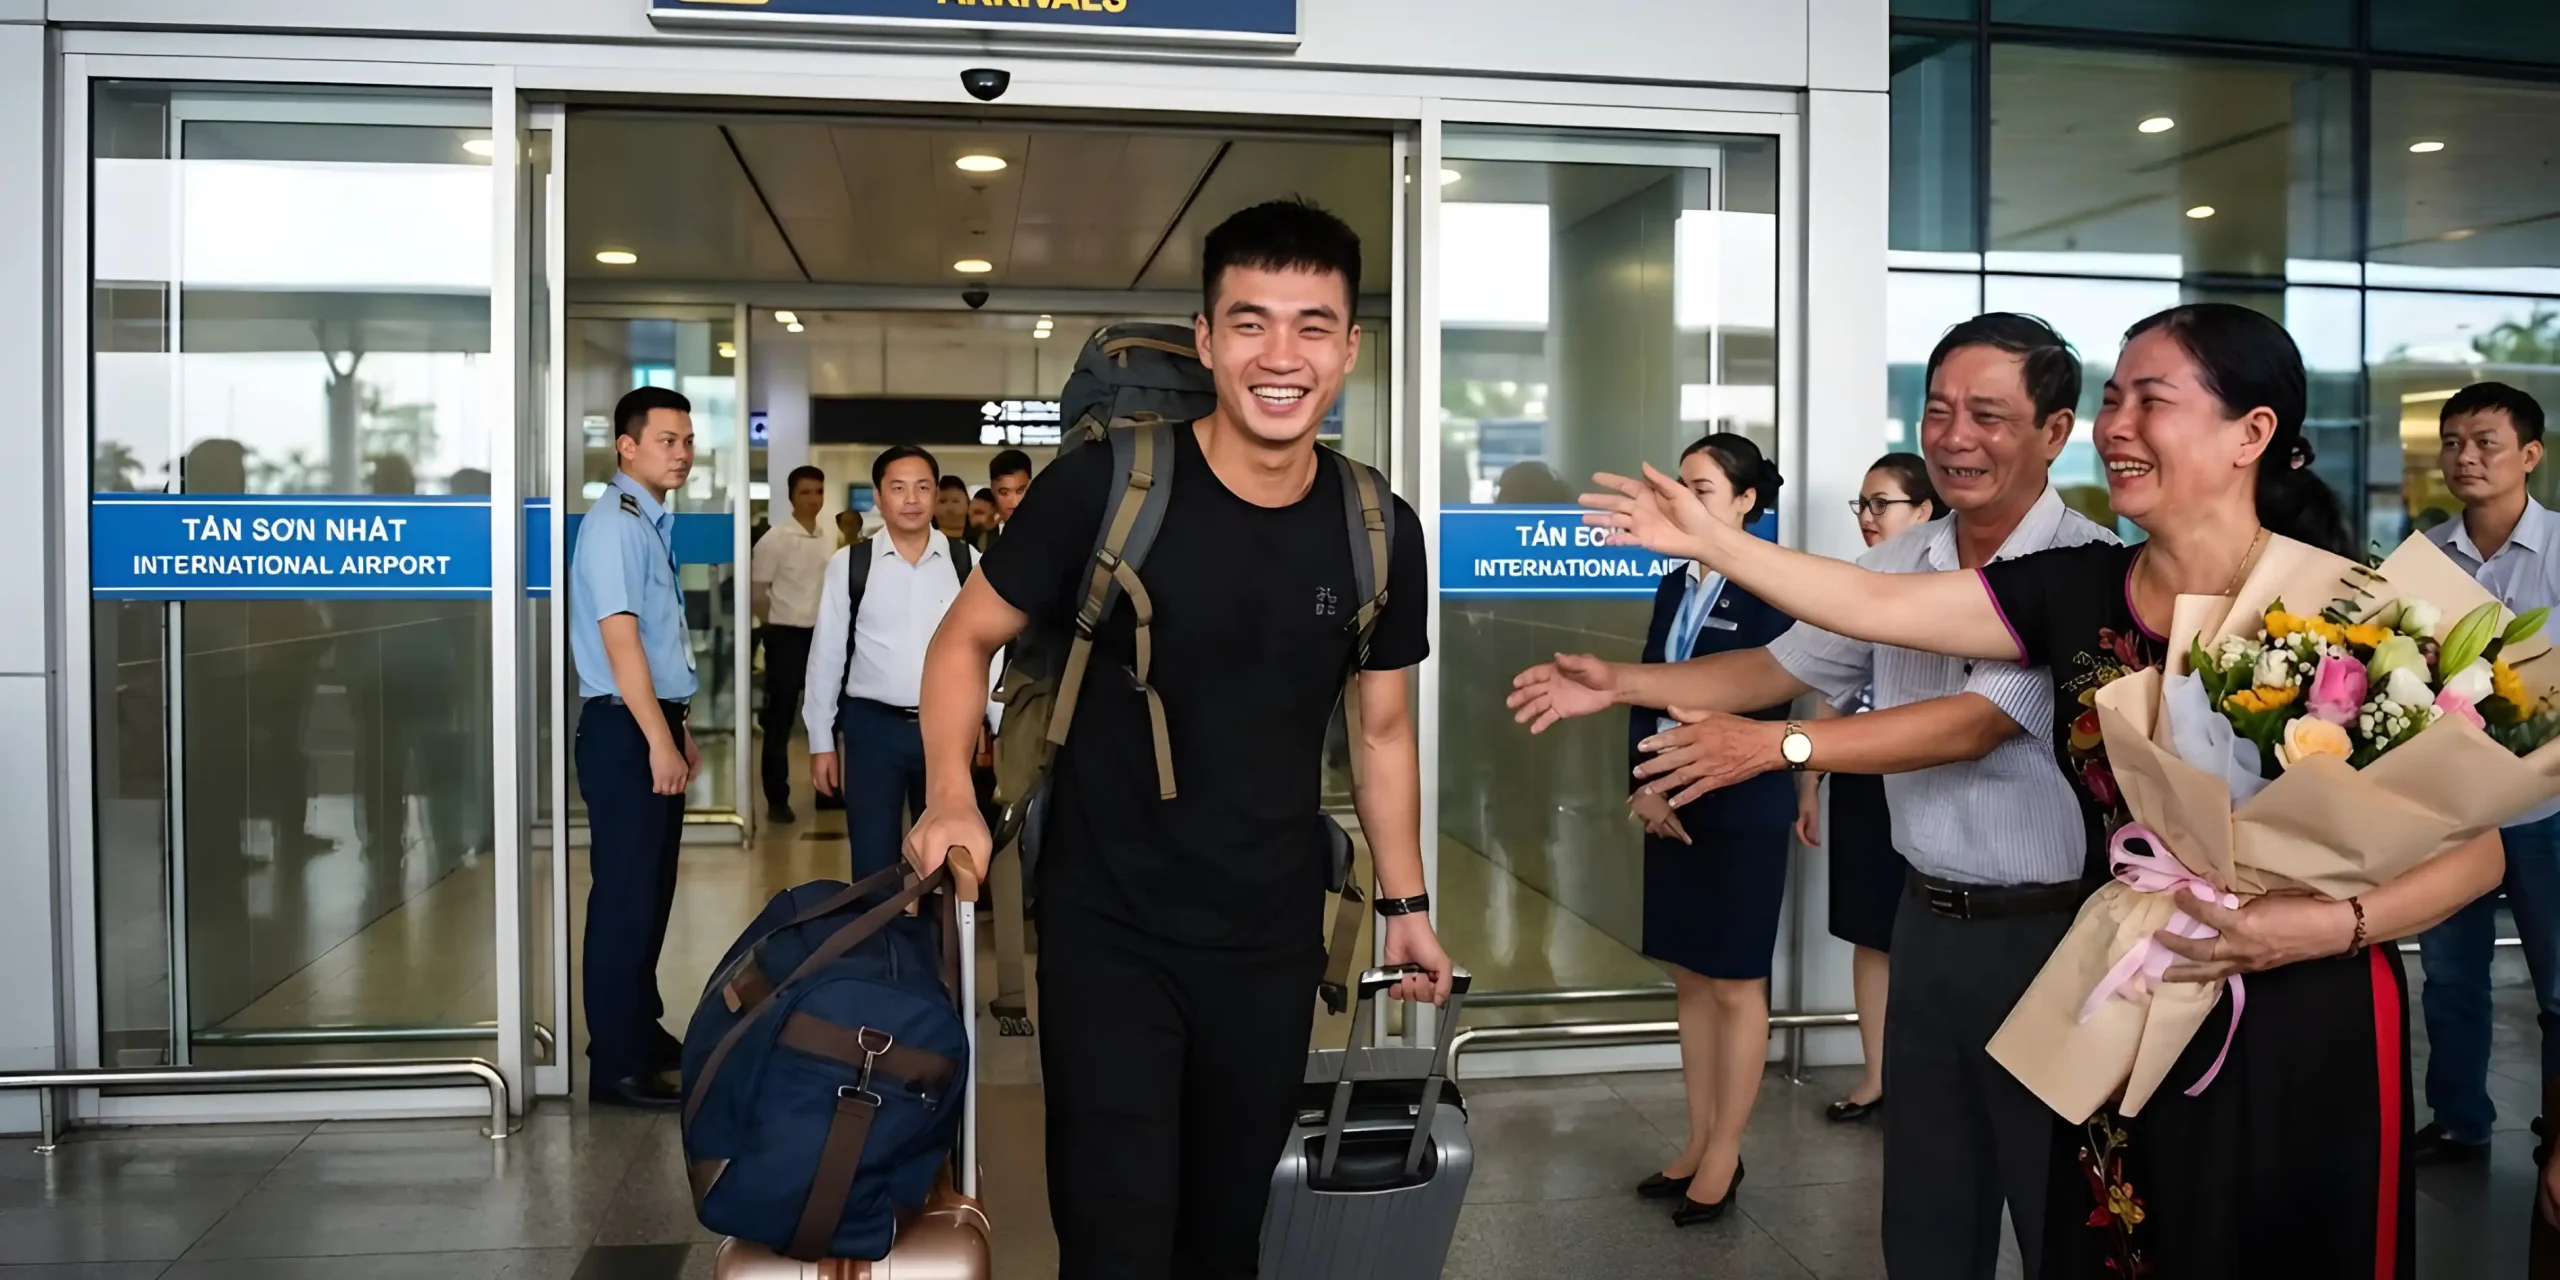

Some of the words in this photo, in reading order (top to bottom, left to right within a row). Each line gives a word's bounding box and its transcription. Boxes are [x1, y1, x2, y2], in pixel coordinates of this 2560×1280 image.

[252, 517, 315, 542] SƠN
[133, 555, 334, 575] INTERNATIONAL
[339, 555, 451, 575] AIRPORT
[1474, 558, 1644, 577] INTERNATIONAL
